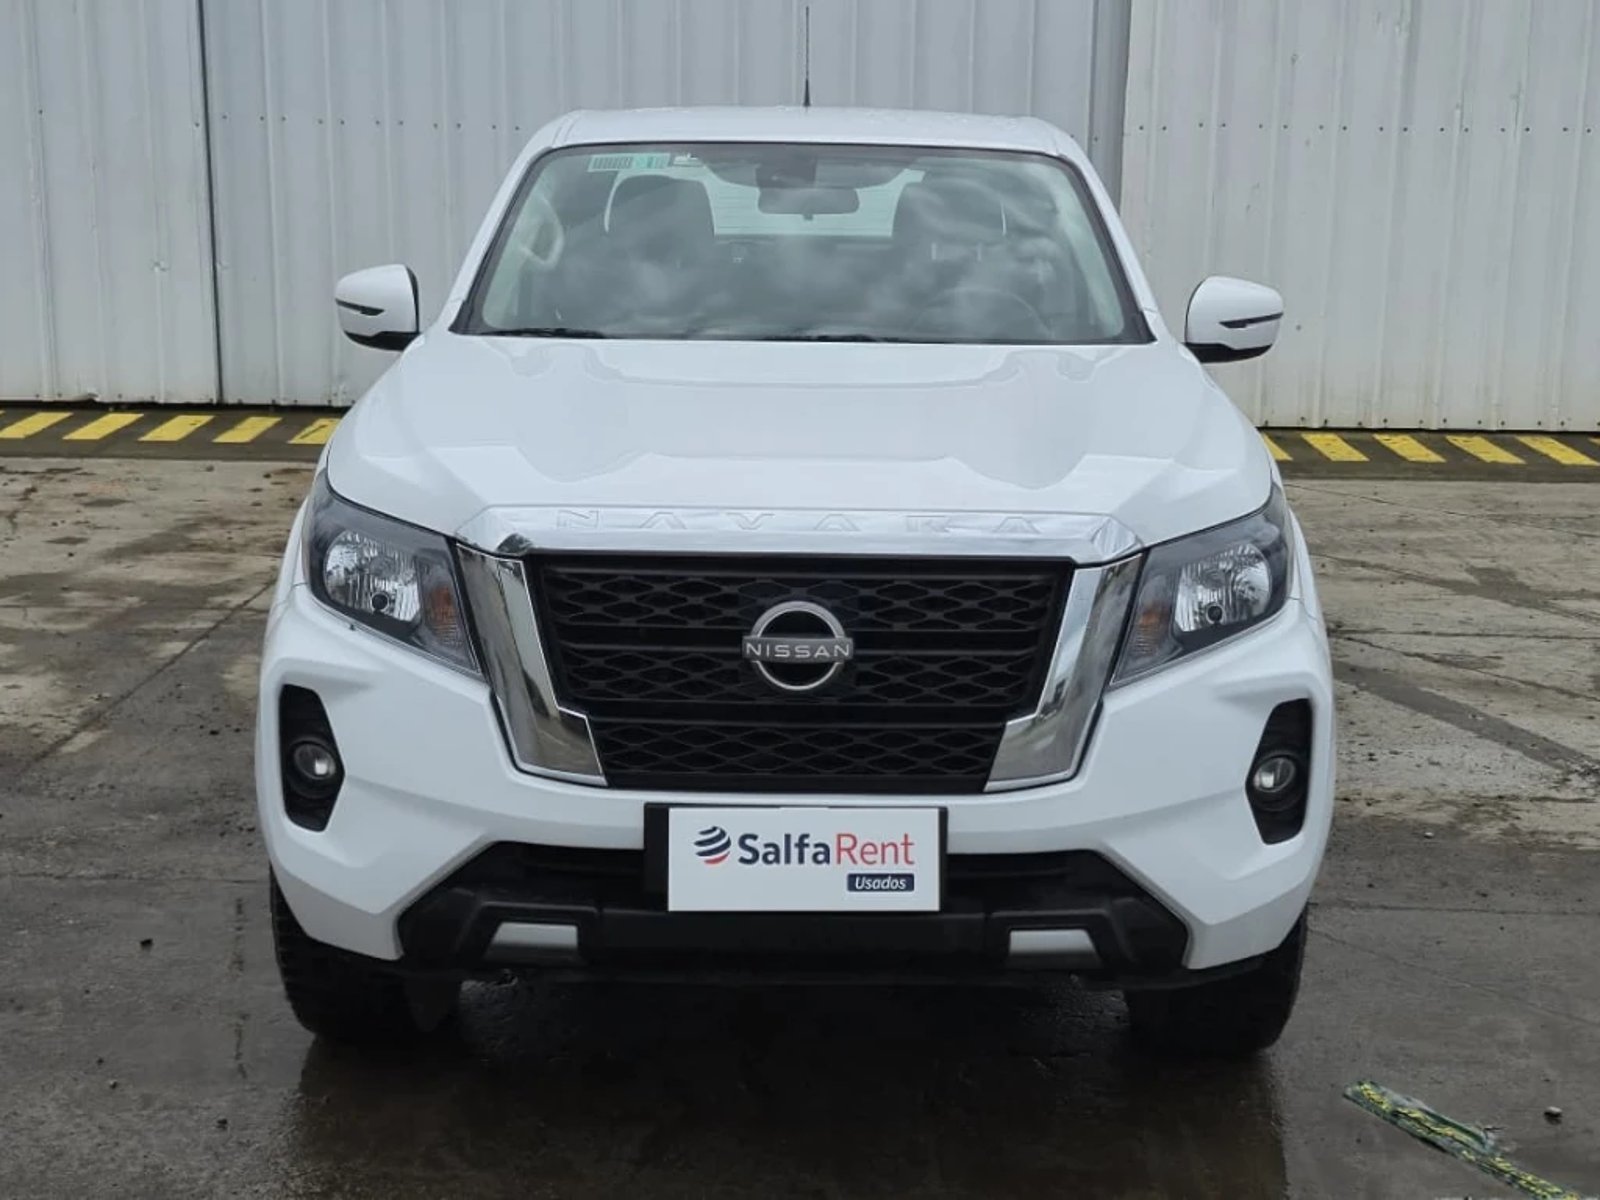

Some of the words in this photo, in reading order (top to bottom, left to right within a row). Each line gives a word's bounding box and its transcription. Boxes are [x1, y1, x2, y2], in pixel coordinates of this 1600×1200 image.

[556, 509, 1042, 534] NAVARA
[746, 642, 849, 658] NISSAN
[855, 876, 906, 890] Usados
